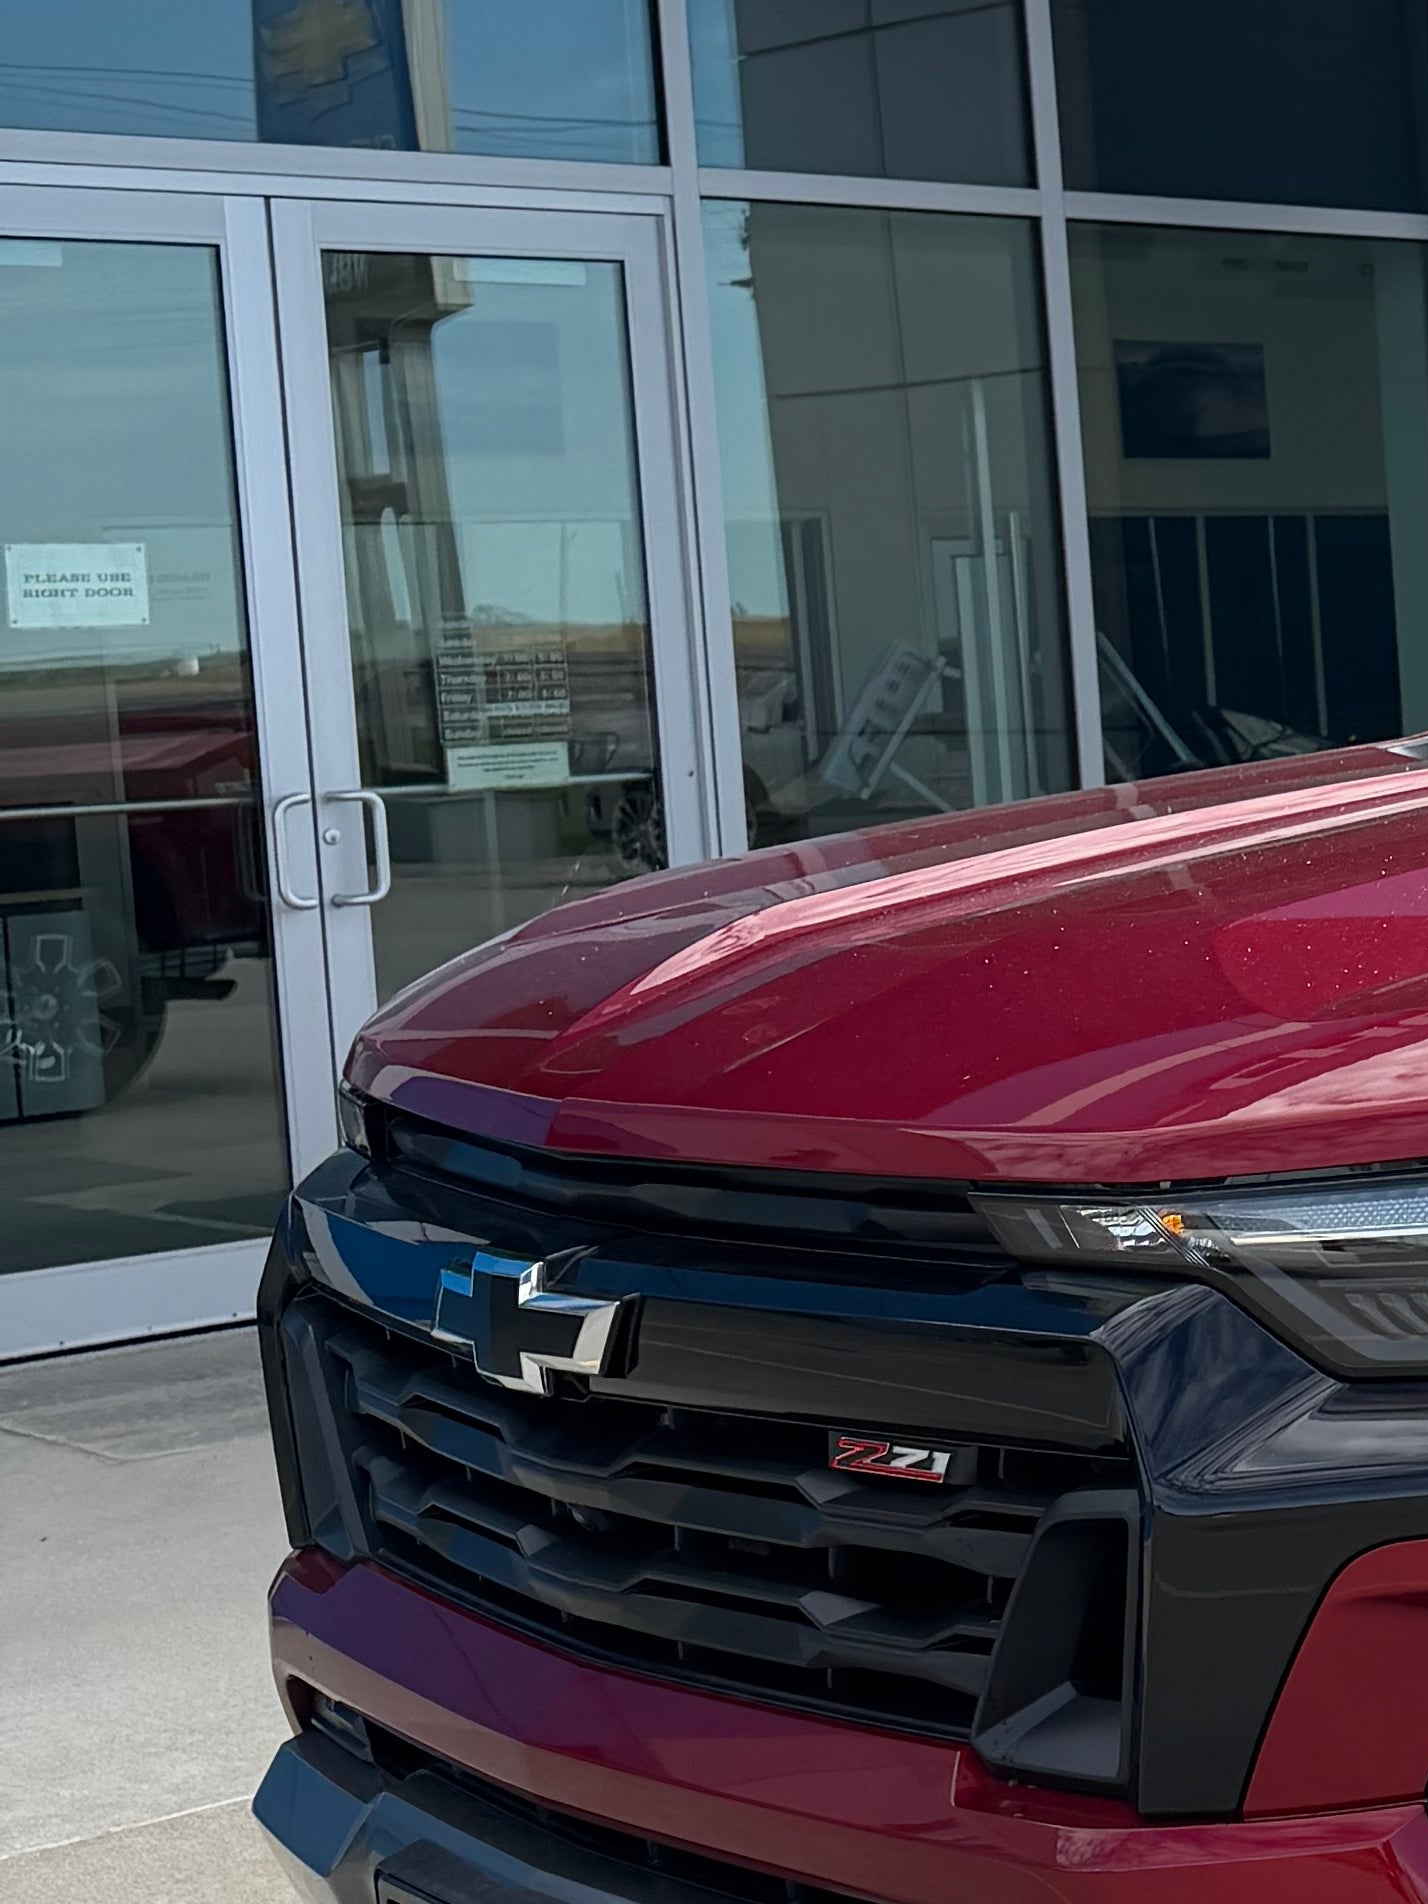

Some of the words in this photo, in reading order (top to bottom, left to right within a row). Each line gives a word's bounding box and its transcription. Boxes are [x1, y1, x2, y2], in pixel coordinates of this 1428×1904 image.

[24, 572, 91, 584] PLEASE
[97, 572, 132, 583] USE
[23, 587, 79, 599] RIGHT
[85, 587, 134, 598] DOOR
[829, 1435, 951, 1483] Z71
